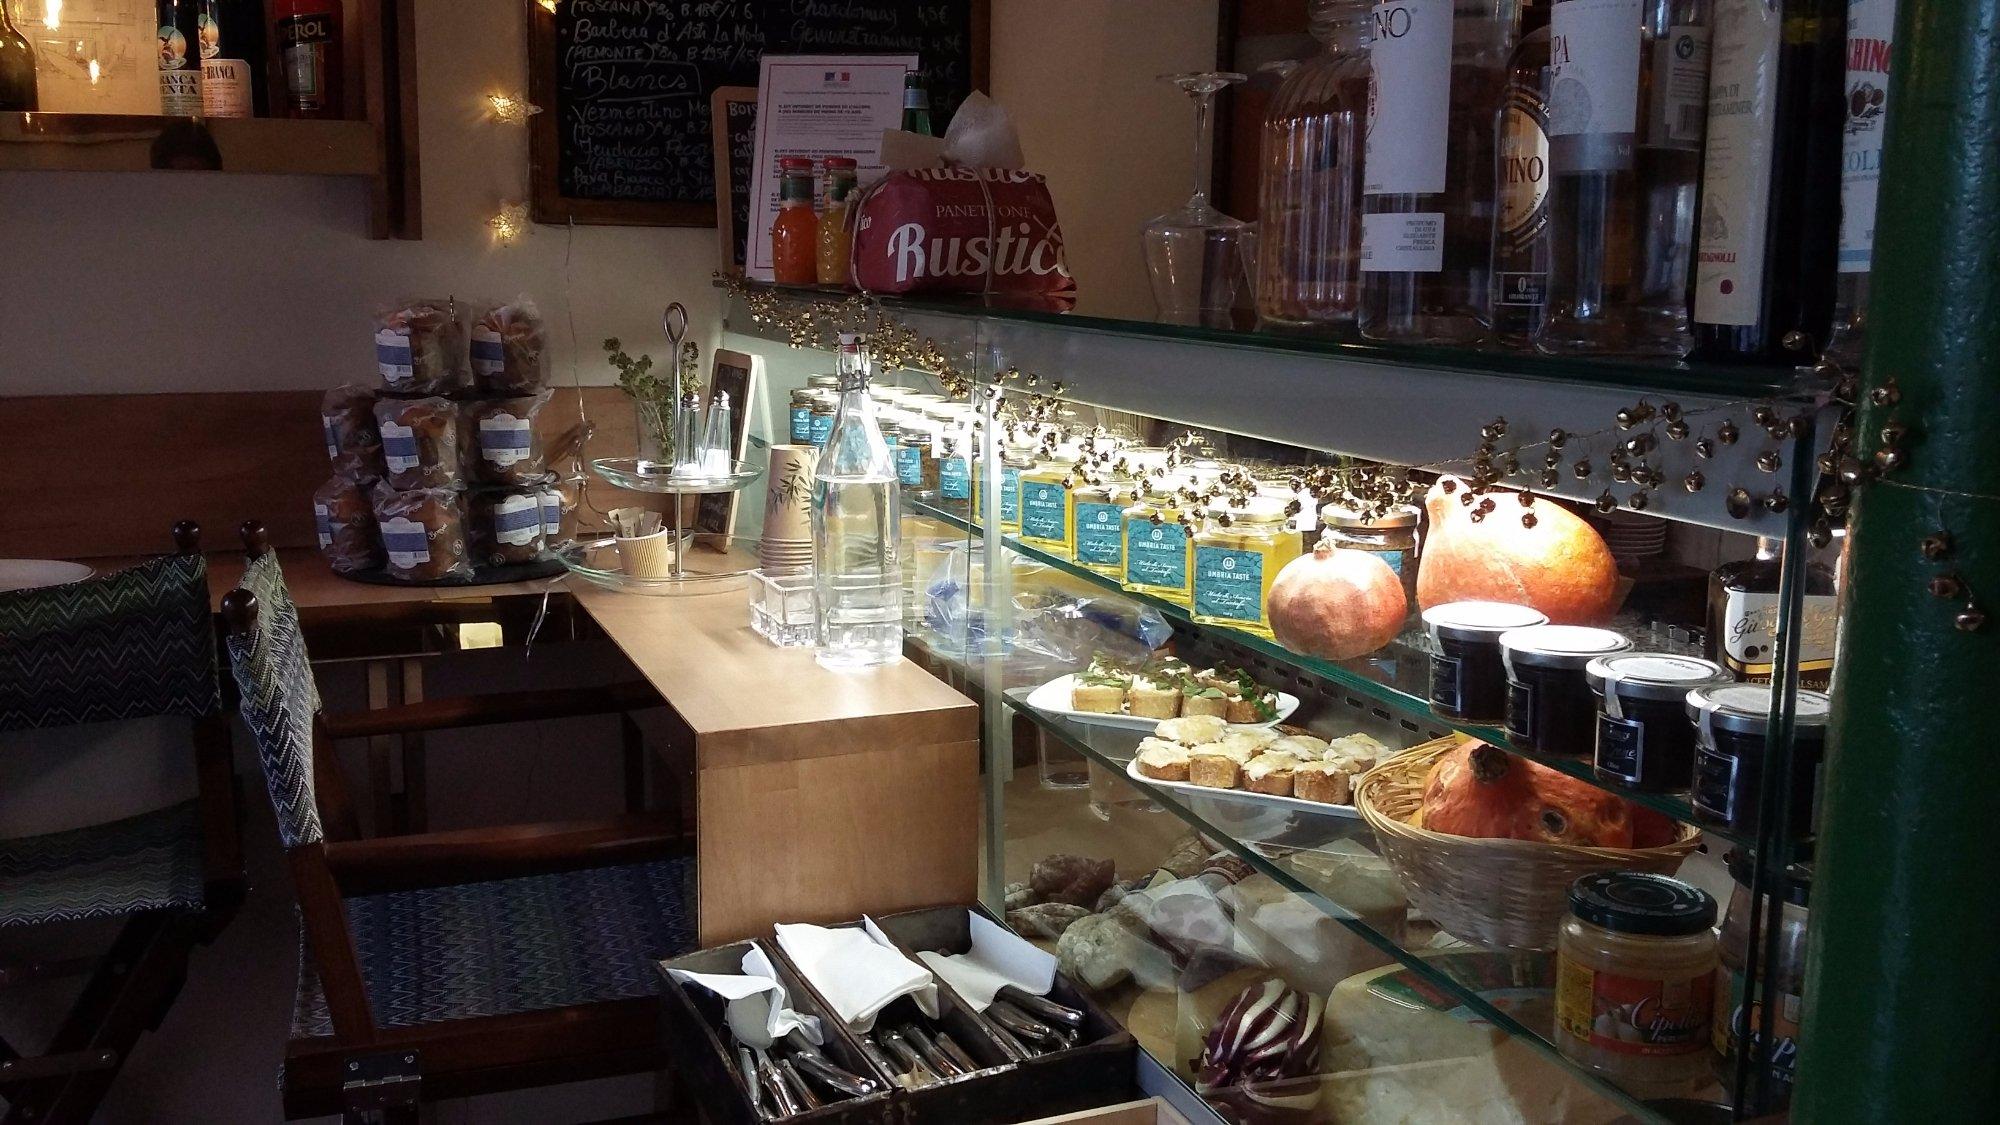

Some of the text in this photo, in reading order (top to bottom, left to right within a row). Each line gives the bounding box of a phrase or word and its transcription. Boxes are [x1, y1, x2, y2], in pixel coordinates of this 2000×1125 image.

[578, 64, 690, 98] Blancs
[936, 204, 1030, 218] PANETONE
[1085, 523, 1105, 531] UMBRIA
[1138, 541, 1176, 551] UMBRIA TASTE
[1207, 570, 1250, 581] UMBRIA TASTE
